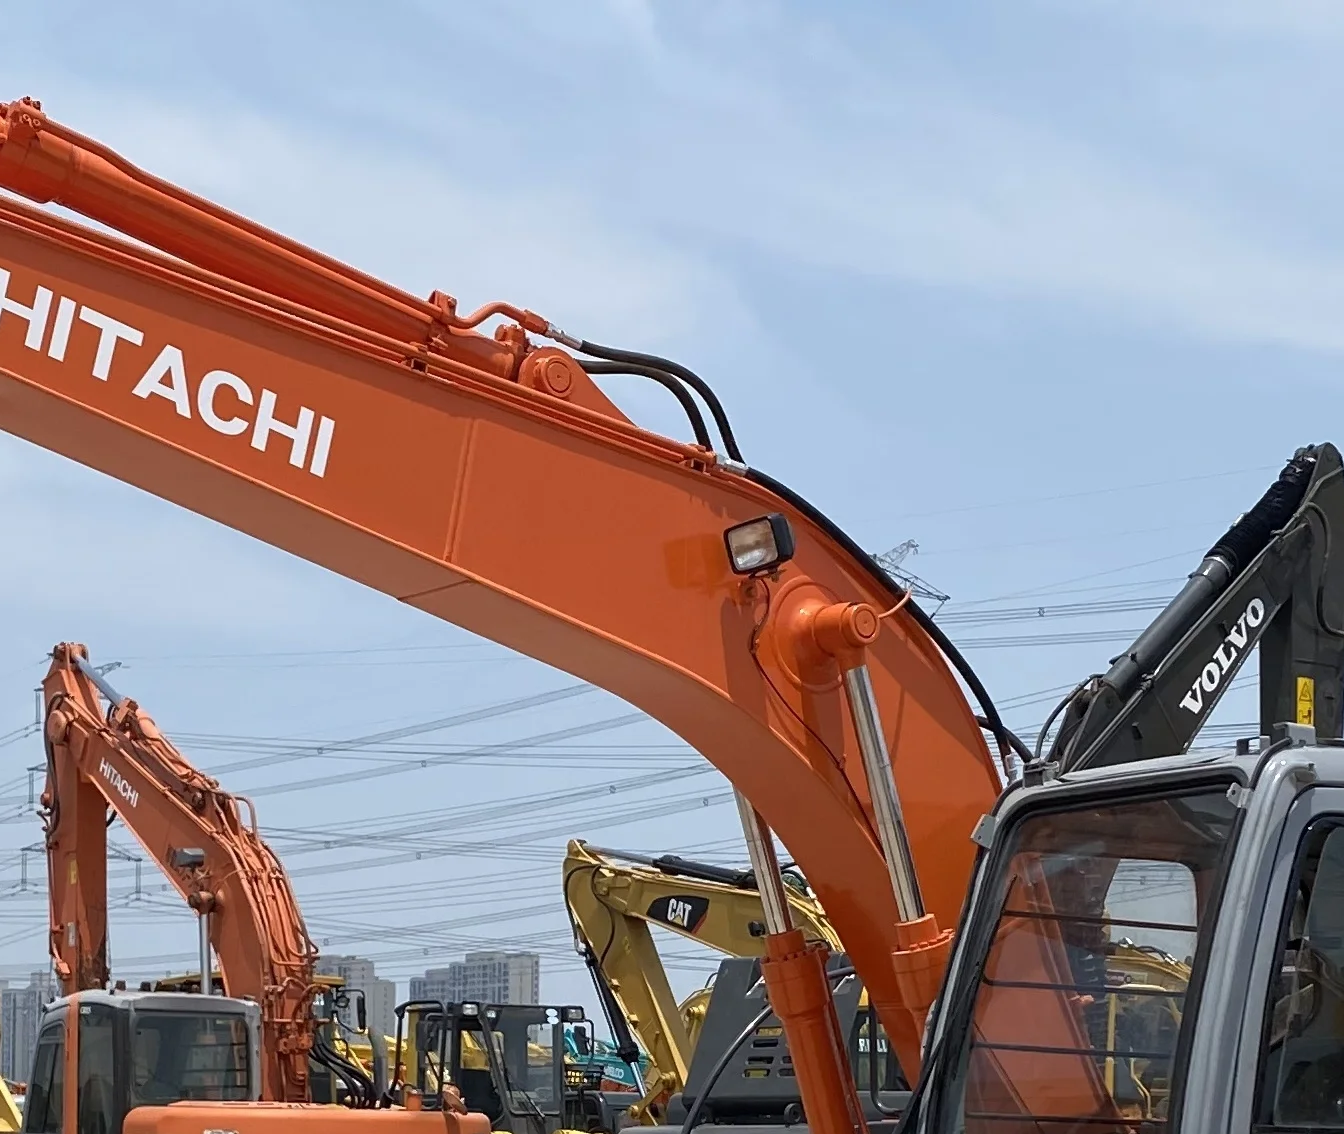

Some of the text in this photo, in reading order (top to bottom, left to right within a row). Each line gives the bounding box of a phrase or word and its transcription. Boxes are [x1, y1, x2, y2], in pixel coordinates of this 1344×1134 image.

[1179, 598, 1265, 714] VOLVO
[99, 756, 139, 808] HITACHI
[667, 898, 692, 927] CAT
